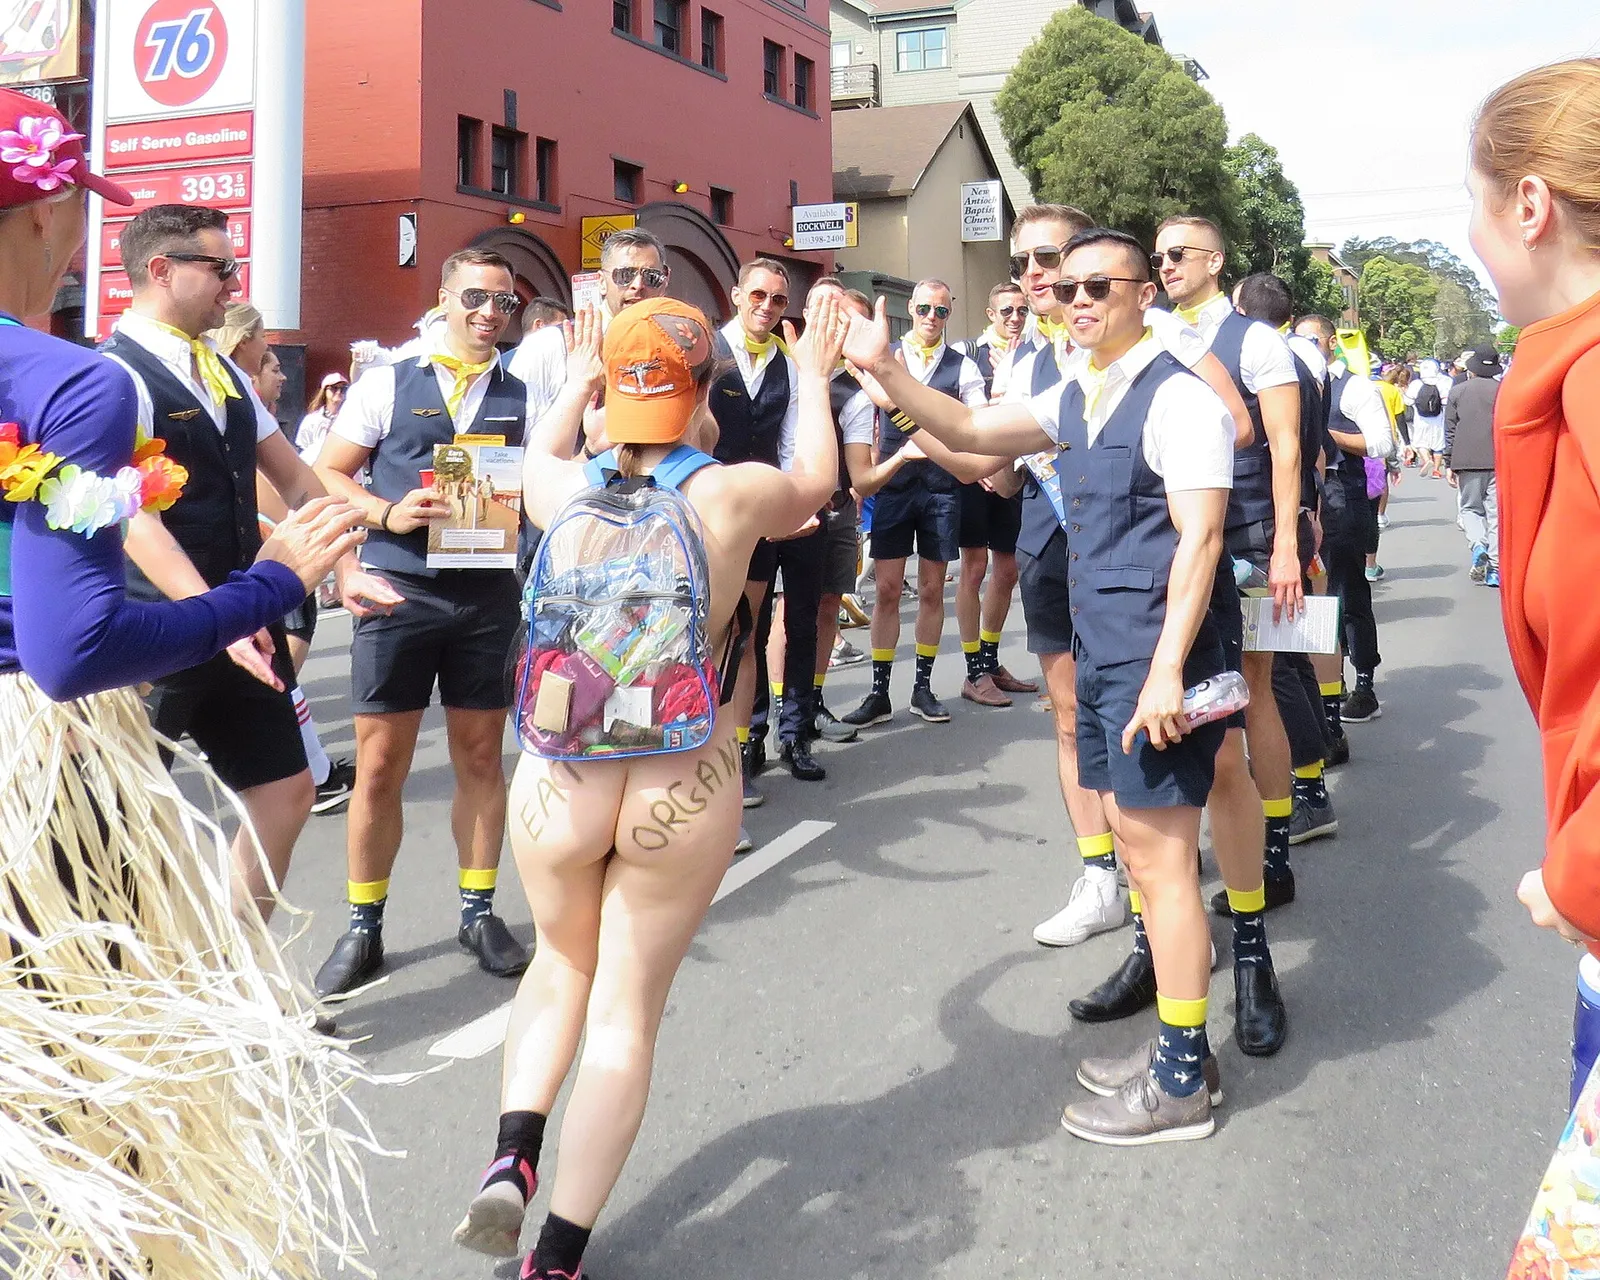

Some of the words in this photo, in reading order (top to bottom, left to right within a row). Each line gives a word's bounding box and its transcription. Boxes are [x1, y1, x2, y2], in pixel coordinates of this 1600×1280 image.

[145, 8, 214, 82] 76
[110, 138, 138, 153] Self
[141, 136, 182, 151] Serve
[185, 128, 248, 146] Gasoline
[129, 188, 157, 200] ular
[181, 174, 234, 202] 393
[971, 187, 990, 196] New
[964, 196, 997, 206] Antioch
[802, 209, 838, 219] Available
[964, 205, 996, 217] Baptist
[964, 215, 997, 225] Church
[797, 220, 842, 232] ROCKWELL
[640, 383, 675, 394] ALLIANCE
